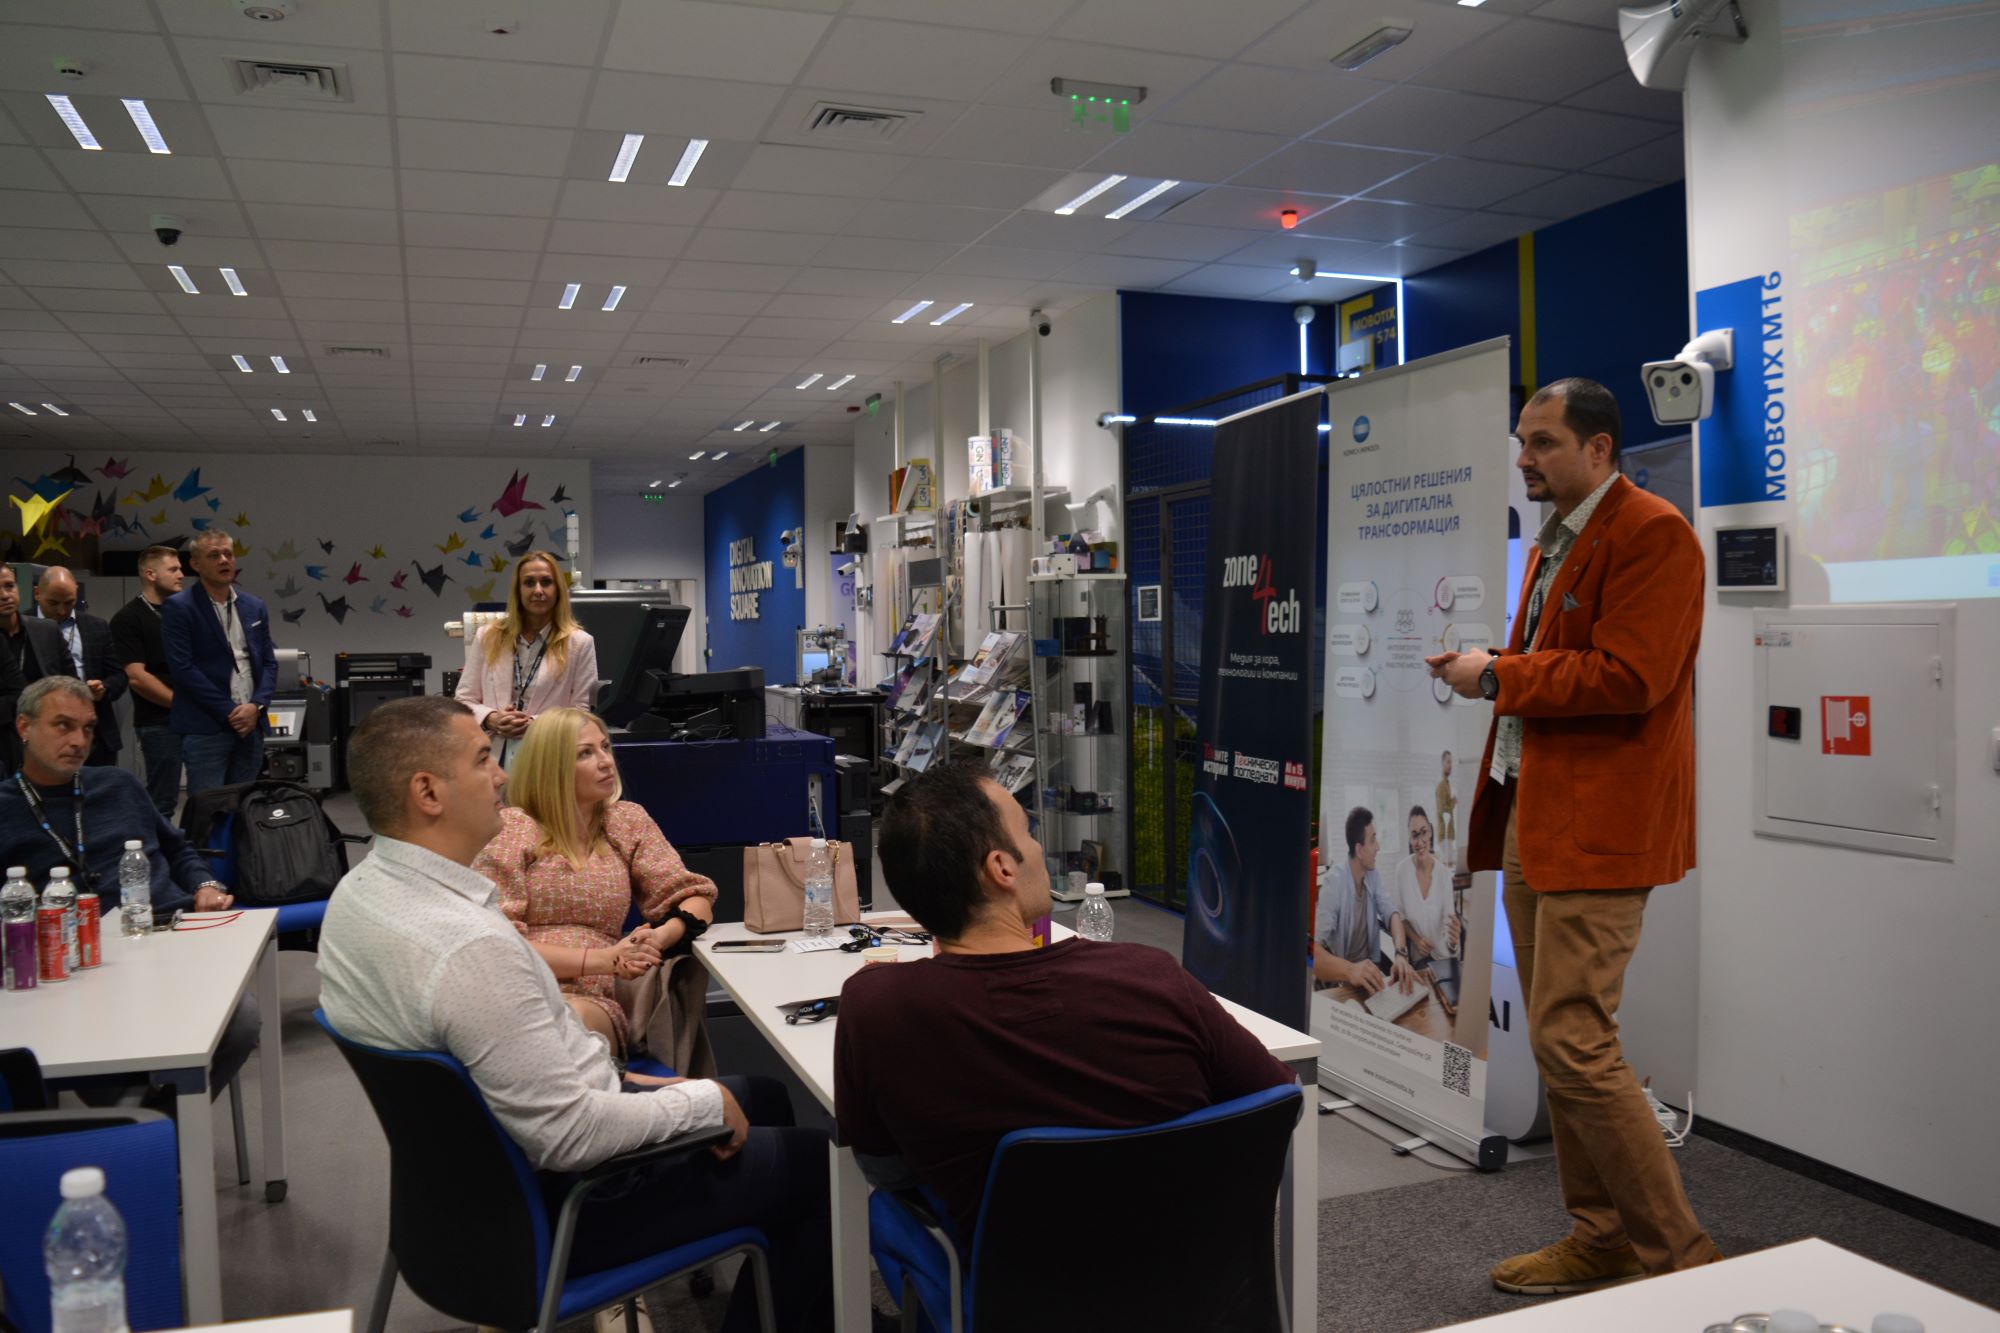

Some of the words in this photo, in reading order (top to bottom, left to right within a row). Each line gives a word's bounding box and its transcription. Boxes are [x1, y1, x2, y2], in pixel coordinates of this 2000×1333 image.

[1762, 270, 1784, 340] M16
[1763, 347, 1787, 501] MOBOTIX
[1351, 476, 1411, 501] ЦЯЛОСТНИ
[1413, 466, 1472, 490] РЕШЕНИЯ
[1366, 503, 1380, 518] ЗА
[1382, 493, 1453, 520] ДИГИТАЛНА
[1358, 515, 1460, 540] ТРАНСФОРМАЦИЯ
[729, 536, 757, 567] DIGITAL
[729, 560, 773, 594] INNOVATION
[730, 592, 760, 620] SQUARE
